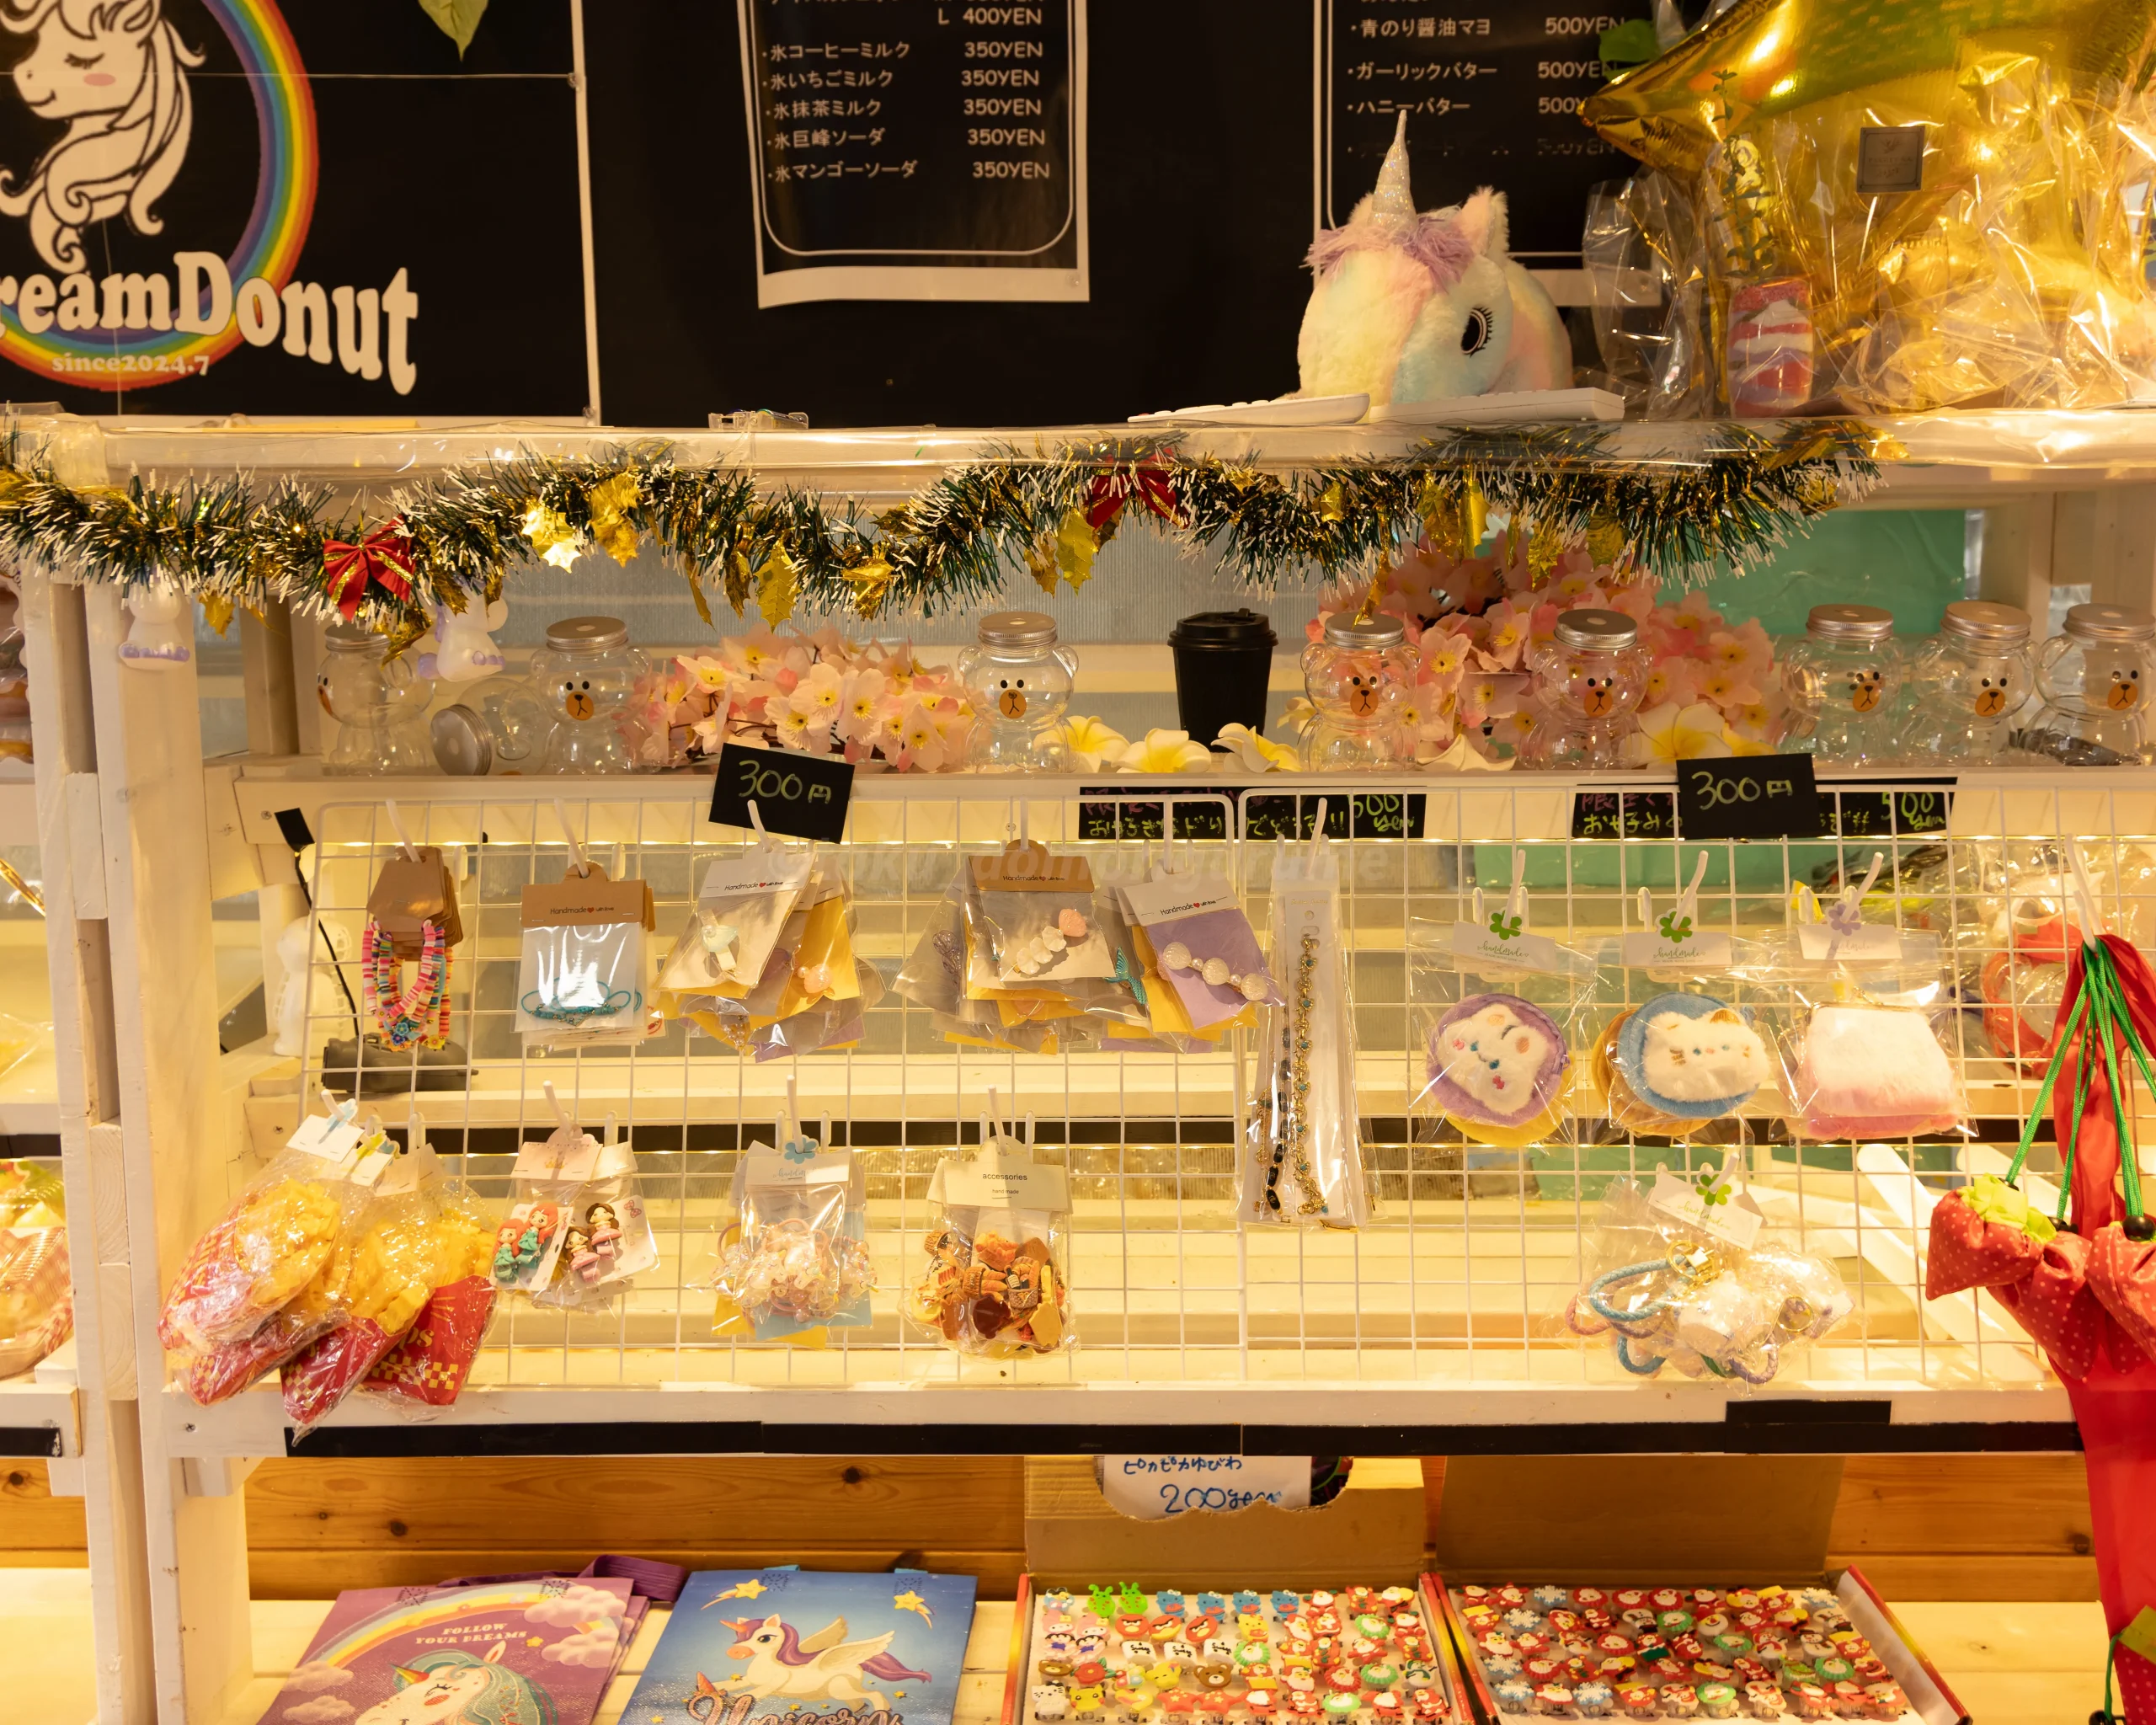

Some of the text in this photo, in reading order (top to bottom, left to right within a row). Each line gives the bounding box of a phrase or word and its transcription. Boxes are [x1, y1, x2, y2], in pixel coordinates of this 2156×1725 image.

[938, 8, 1041, 25] L 400YEN
[965, 41, 1043, 57] 350YEN
[962, 69, 1038, 86] 350YEN
[964, 99, 1041, 115] 350YEN
[969, 129, 1045, 146] 350YEN
[974, 162, 1049, 179] 350YEN
[51, 352, 210, 376] since2024.7
[739, 760, 832, 804] 300円
[1691, 771, 1793, 810] 300円
[724, 882, 758, 891] Handmade
[550, 906, 587, 915] Handmade
[1160, 903, 1194, 916] Handmade
[441, 1623, 509, 1636] FOLLOW
[462, 1631, 527, 1643] DREAMS
